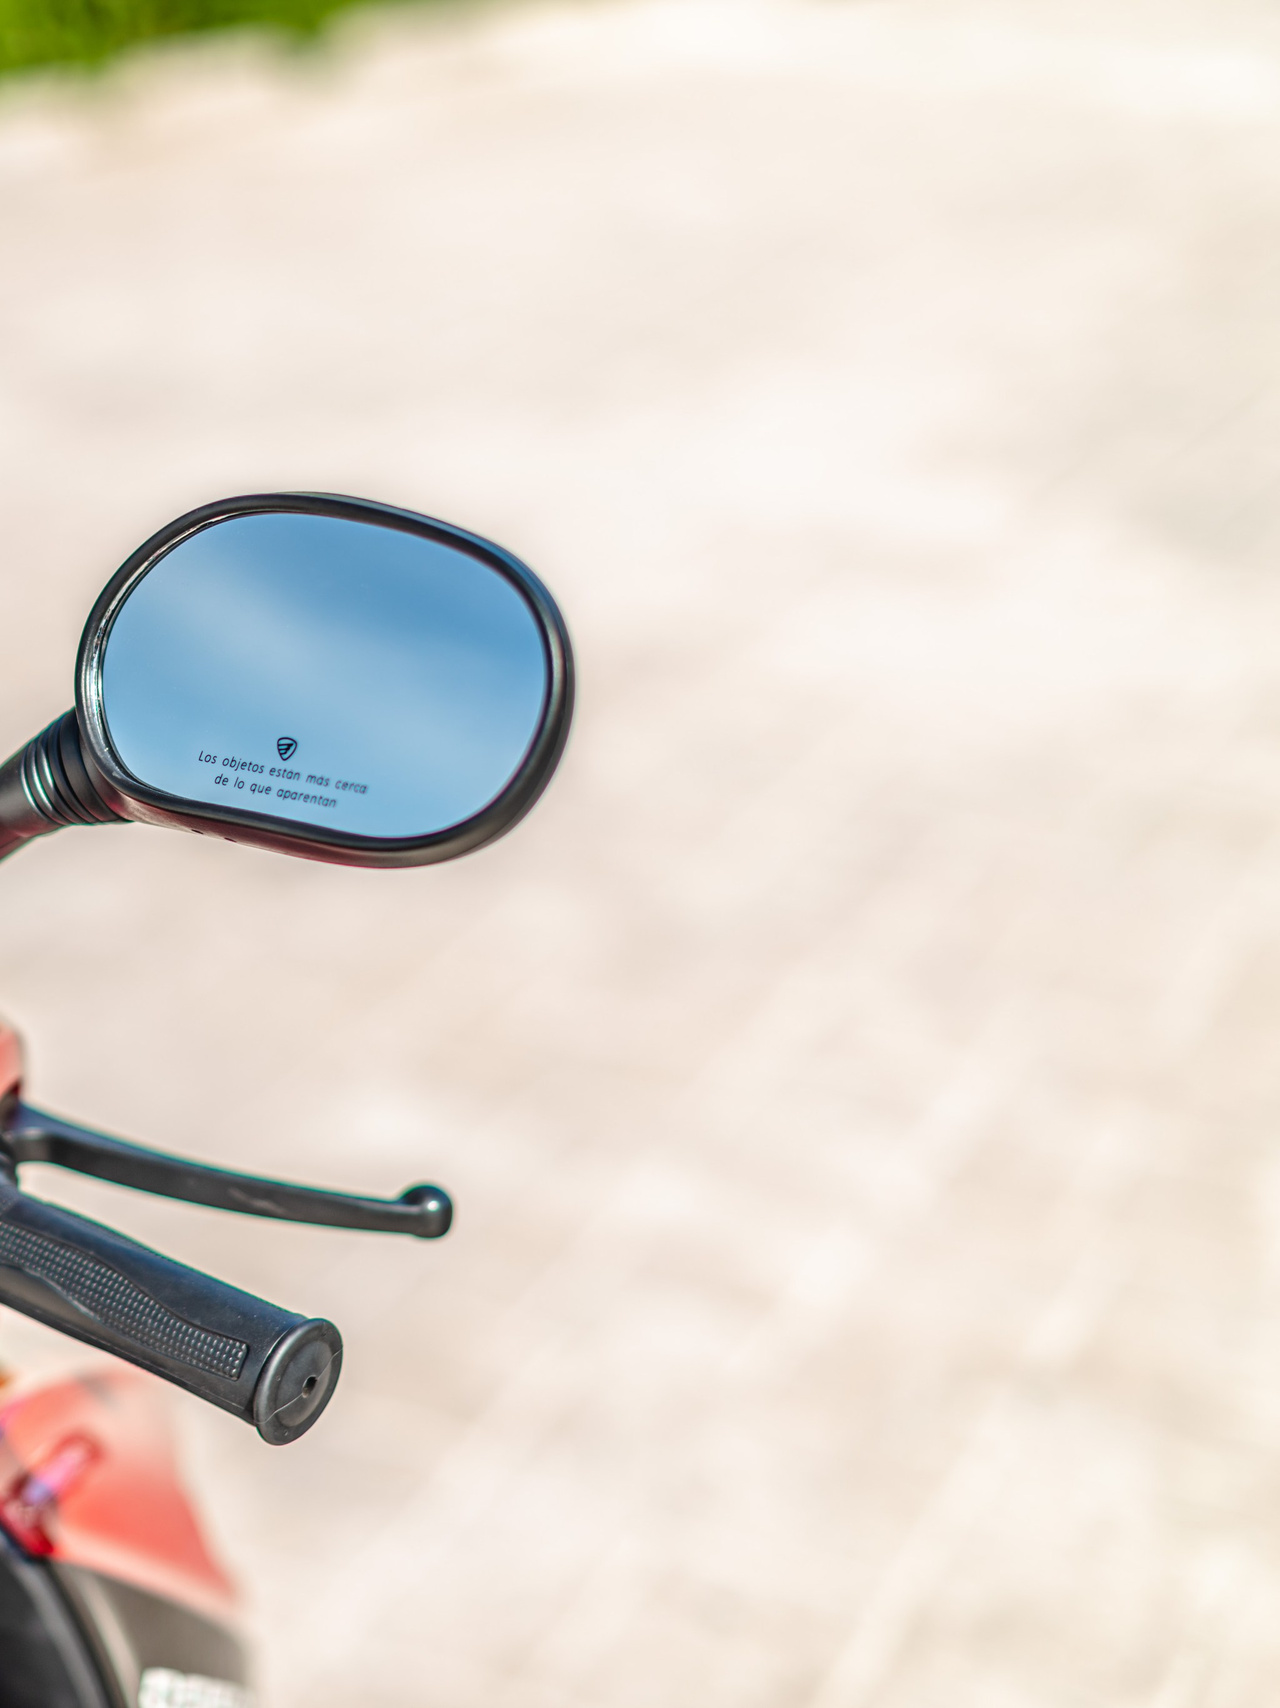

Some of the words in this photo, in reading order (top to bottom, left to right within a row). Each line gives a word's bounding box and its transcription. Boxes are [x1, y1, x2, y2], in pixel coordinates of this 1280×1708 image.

[198, 750, 218, 765] Los
[222, 756, 265, 774] objetos
[334, 779, 369, 795] cerca
[214, 773, 229, 787] de
[234, 777, 245, 790] lo
[250, 782, 272, 795] que
[276, 787, 337, 808] aparentan
